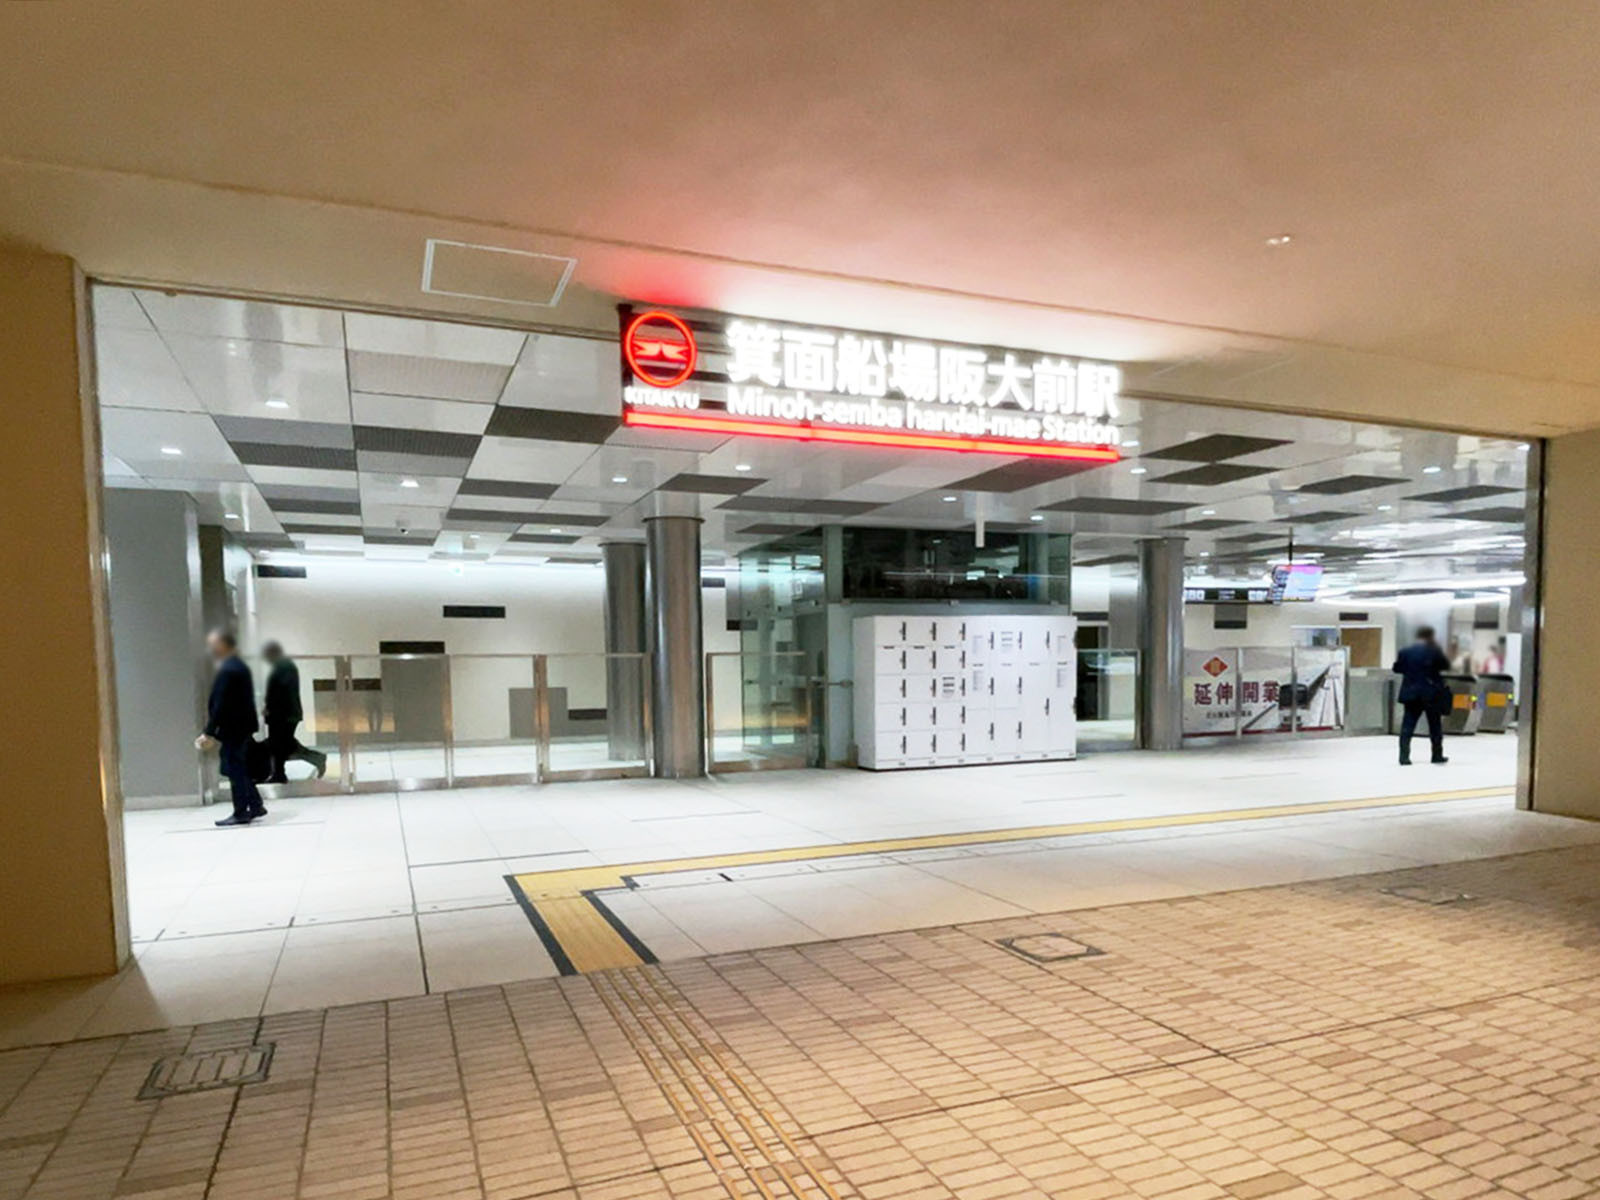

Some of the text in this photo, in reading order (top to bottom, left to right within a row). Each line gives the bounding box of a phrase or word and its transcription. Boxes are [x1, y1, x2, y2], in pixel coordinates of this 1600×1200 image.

[726, 321, 1121, 419] 箕面船場阪大前駅
[727, 386, 1120, 445] Minoh-semba handai-mae Station
[1193, 681, 1280, 705] 延伸開業
